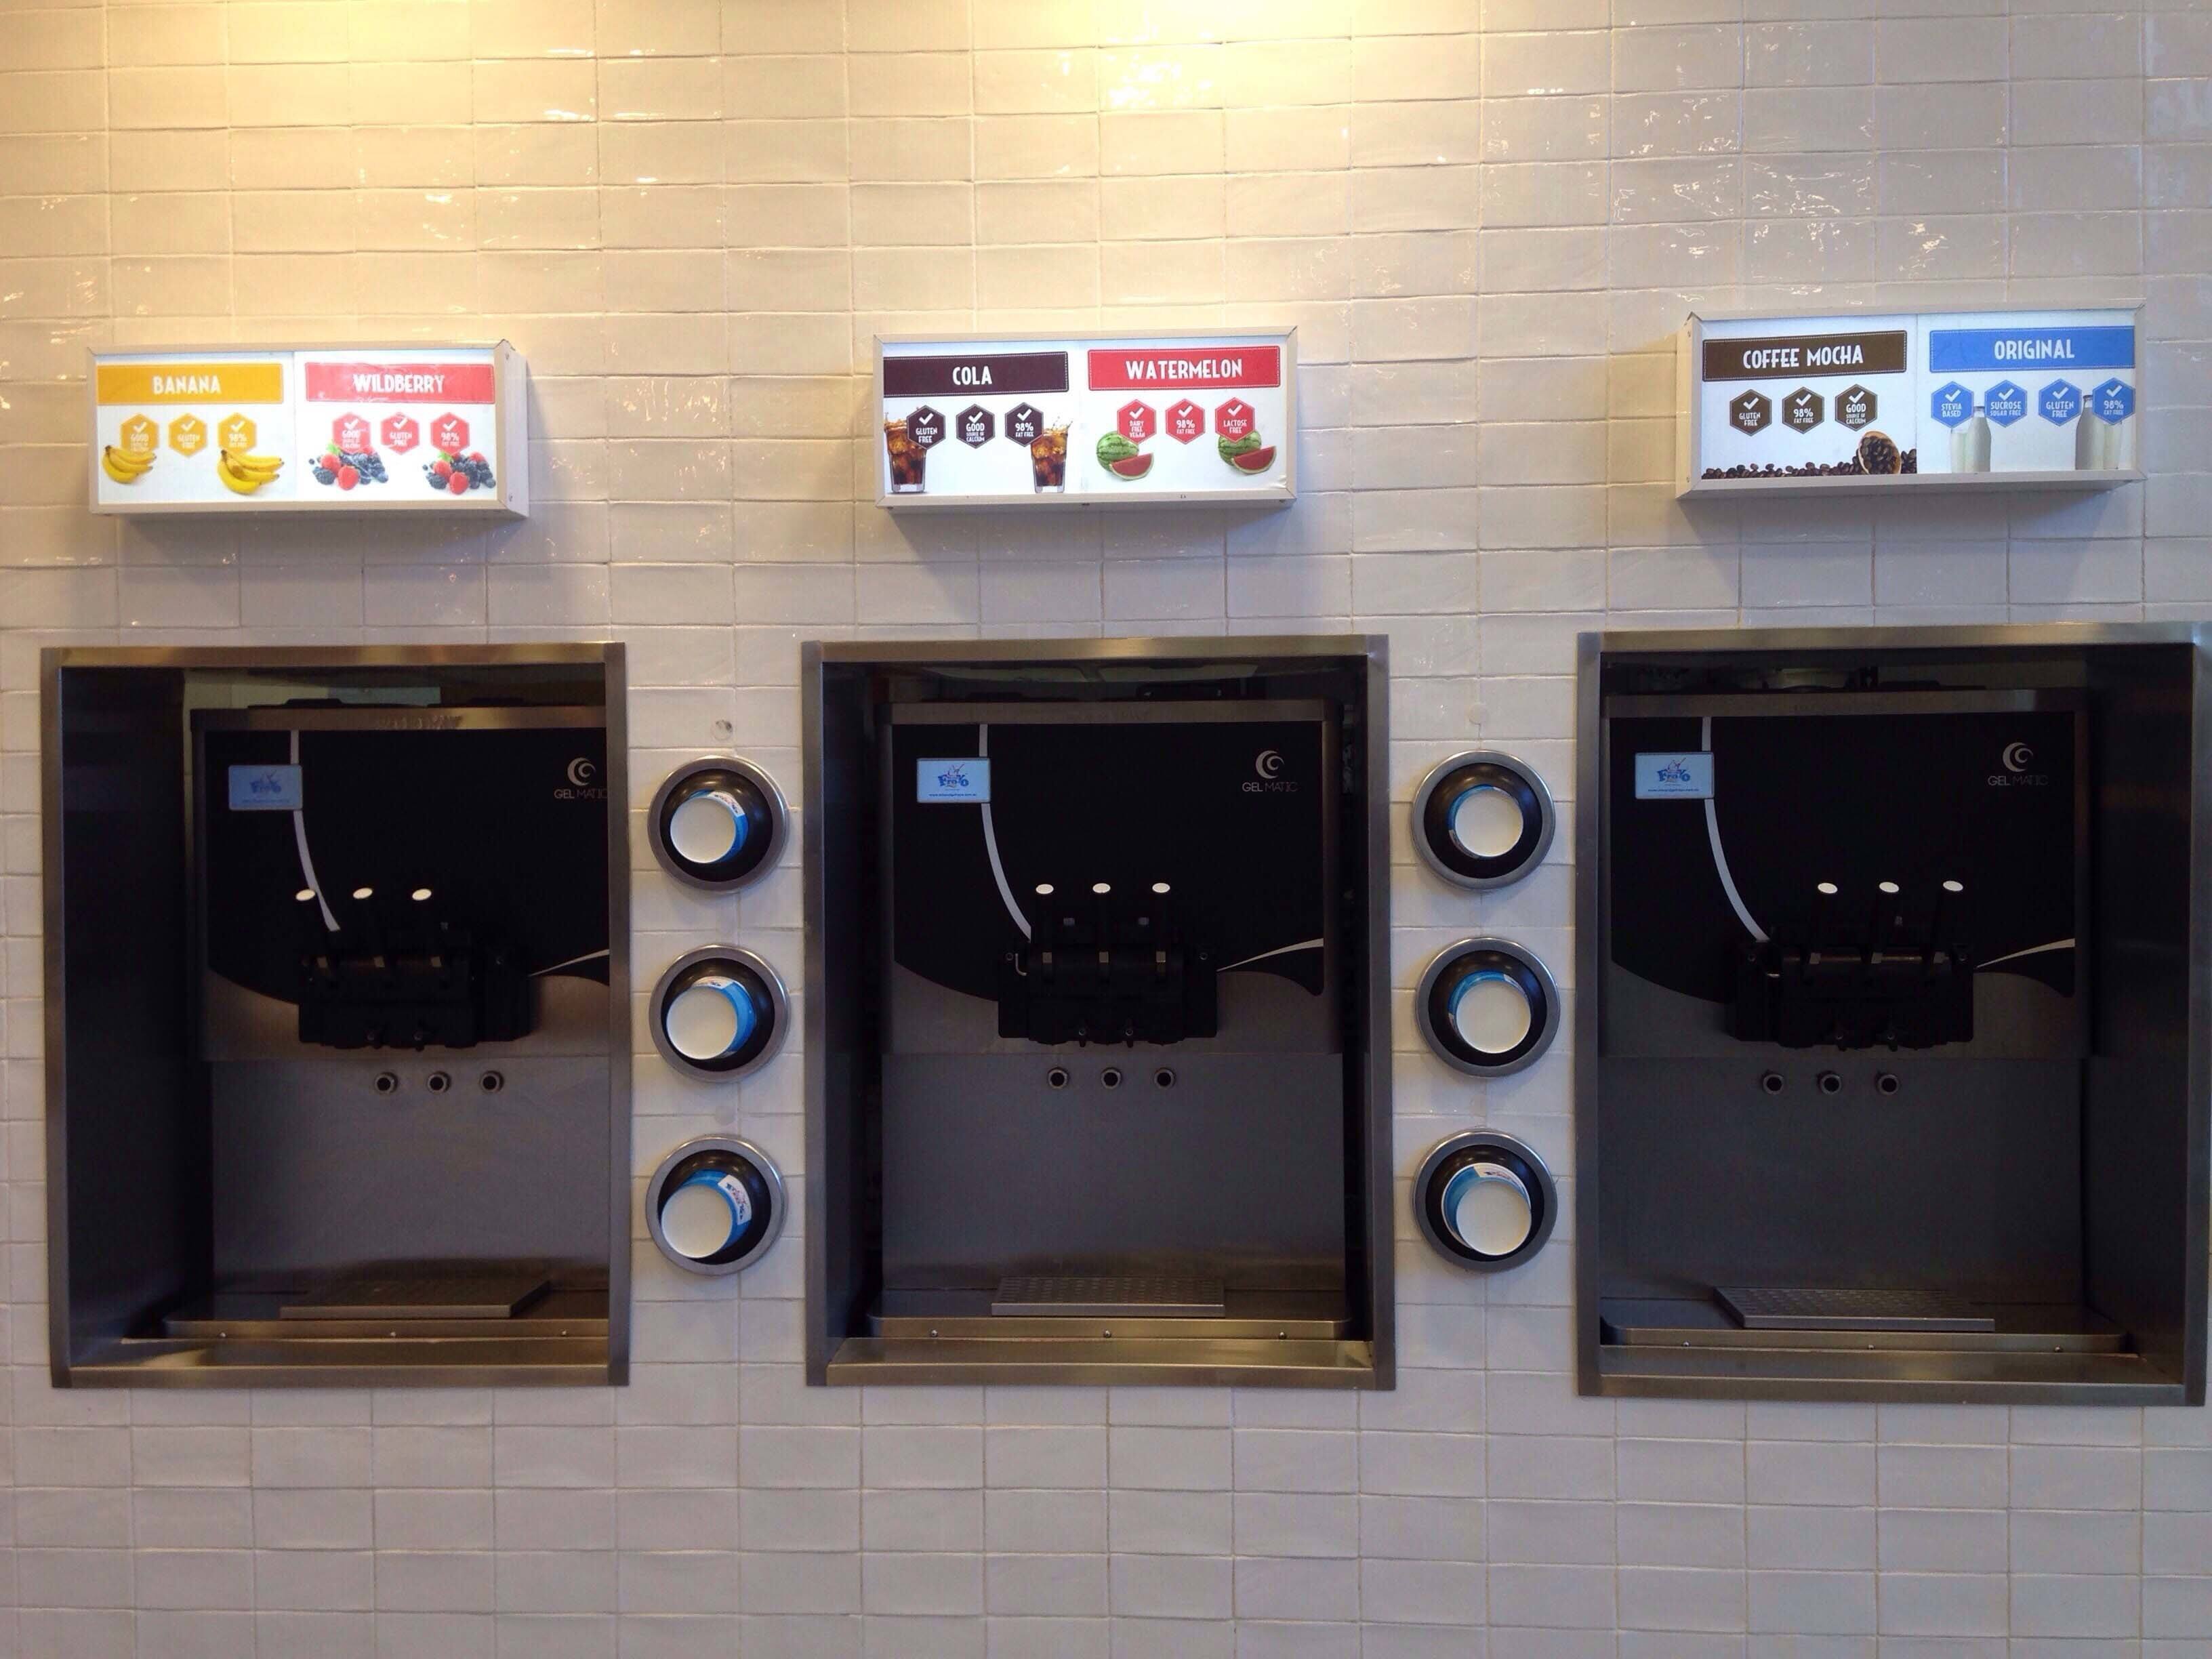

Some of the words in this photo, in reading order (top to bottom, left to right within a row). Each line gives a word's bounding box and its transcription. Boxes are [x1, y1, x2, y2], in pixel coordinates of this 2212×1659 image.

[1994, 339, 2075, 360] ORIGINAL
[1743, 348, 1799, 369] COFFEE
[1807, 344, 1864, 367] MOCHA
[1126, 359, 1242, 380] WATERMELON
[952, 366, 992, 386] COLA
[152, 375, 221, 395] BANANA
[353, 373, 445, 393] WILDBERRY
[1846, 403, 1866, 413] GOOD
[1941, 403, 1962, 411] STEVIA
[1990, 401, 2022, 410] SUCROSE
[2046, 401, 2074, 409] GLUTEN
[2104, 400, 2124, 409] 98%
[1793, 408, 1814, 417] 98%
[966, 423, 985, 432] GOOD
[1015, 422, 1034, 432] 98%
[1176, 419, 1195, 429] 98%
[1223, 419, 1247, 428] LACTOSE
[390, 432, 412, 440] GLUTEN
[916, 427, 938, 435] GLUTEN
[441, 432, 459, 442] 98%
[1987, 775, 2011, 786] GEL
[2012, 775, 2049, 786] MATIC
[1242, 782, 1263, 792] GEL
[1265, 781, 1298, 792] MATIC
[554, 789, 575, 798] GEL
